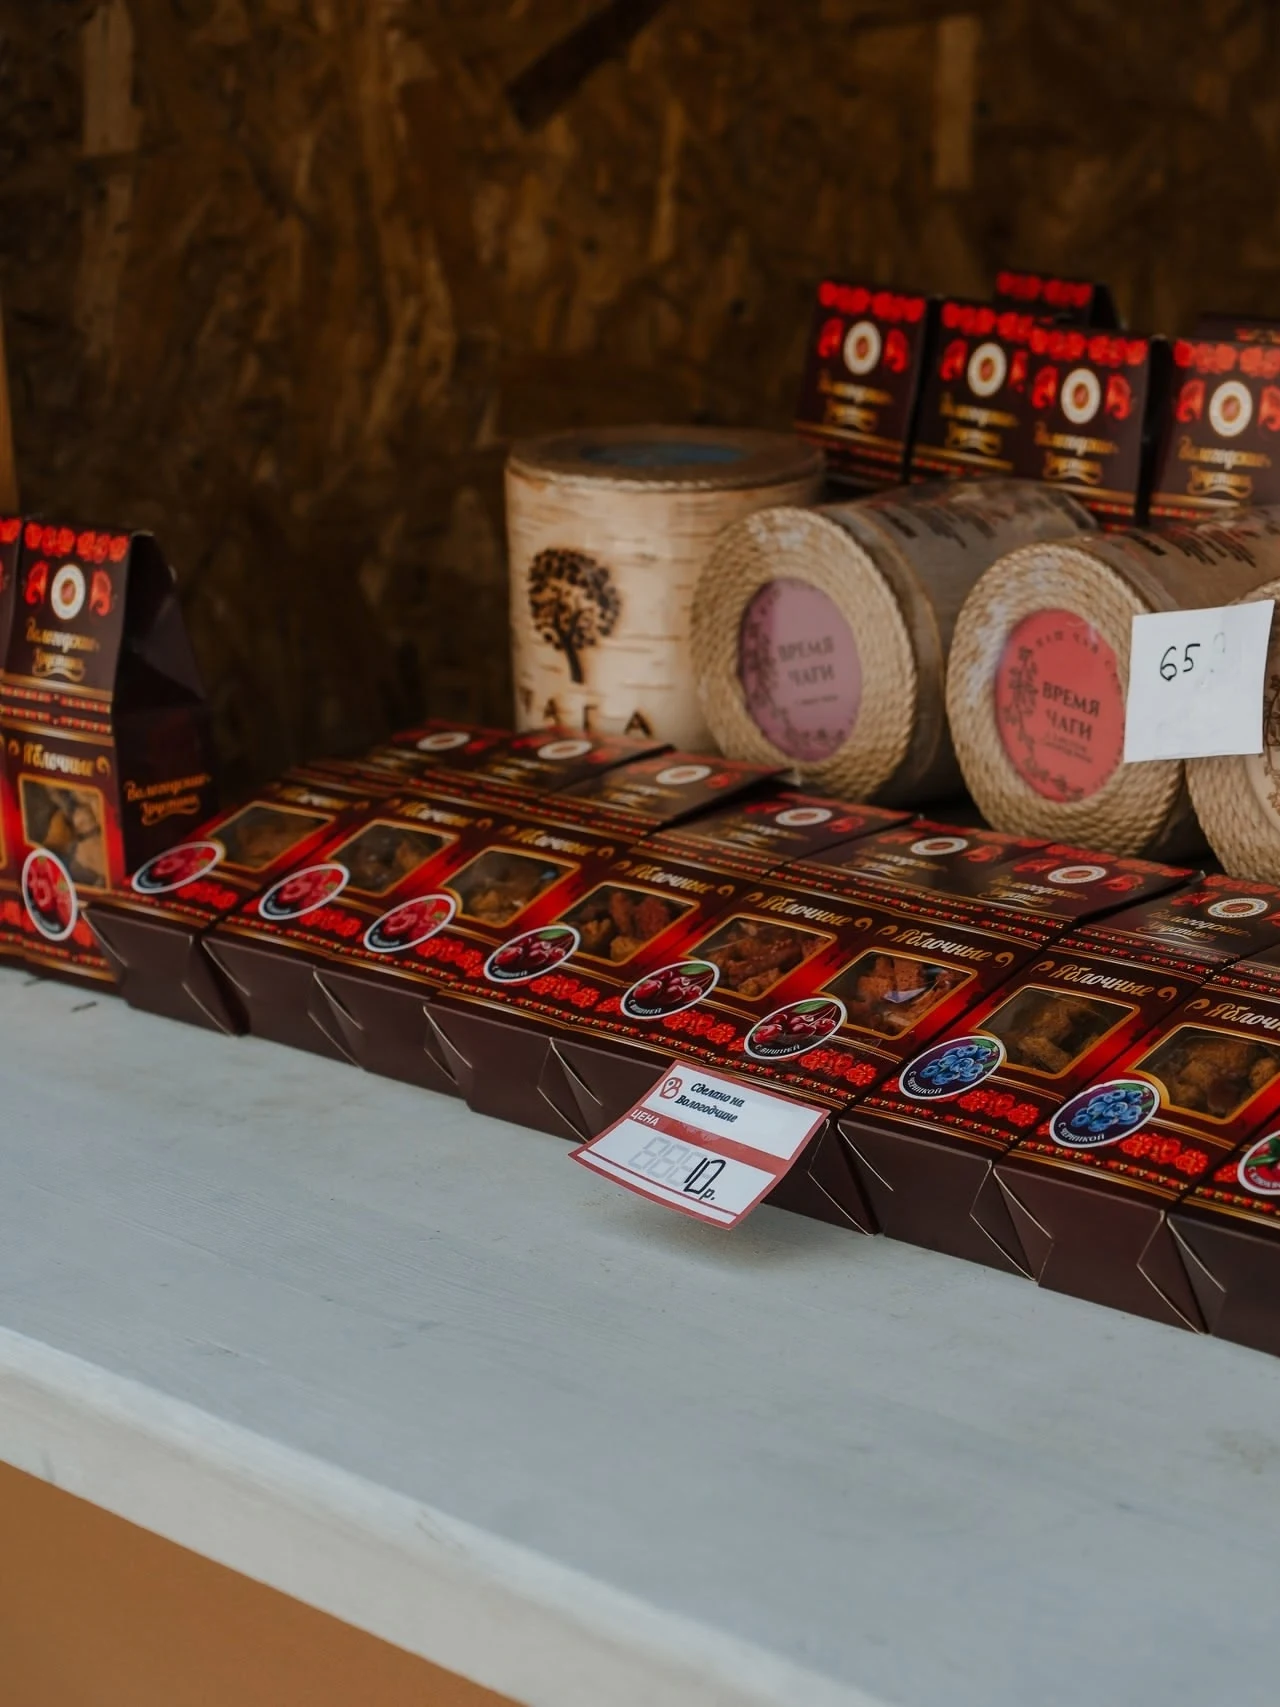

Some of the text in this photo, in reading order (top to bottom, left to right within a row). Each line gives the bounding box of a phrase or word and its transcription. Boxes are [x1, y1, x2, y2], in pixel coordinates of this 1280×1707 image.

[1042, 681, 1100, 718] ВРЕМЯ
[1046, 708, 1093, 741] ЧАГИ
[901, 929, 992, 962] Яблочные
[1050, 963, 1155, 998] Яблочные
[675, 1094, 738, 1123] Вологодчине
[690, 1082, 745, 1108] Сделано на
[630, 1109, 660, 1126] ЦЕНА
